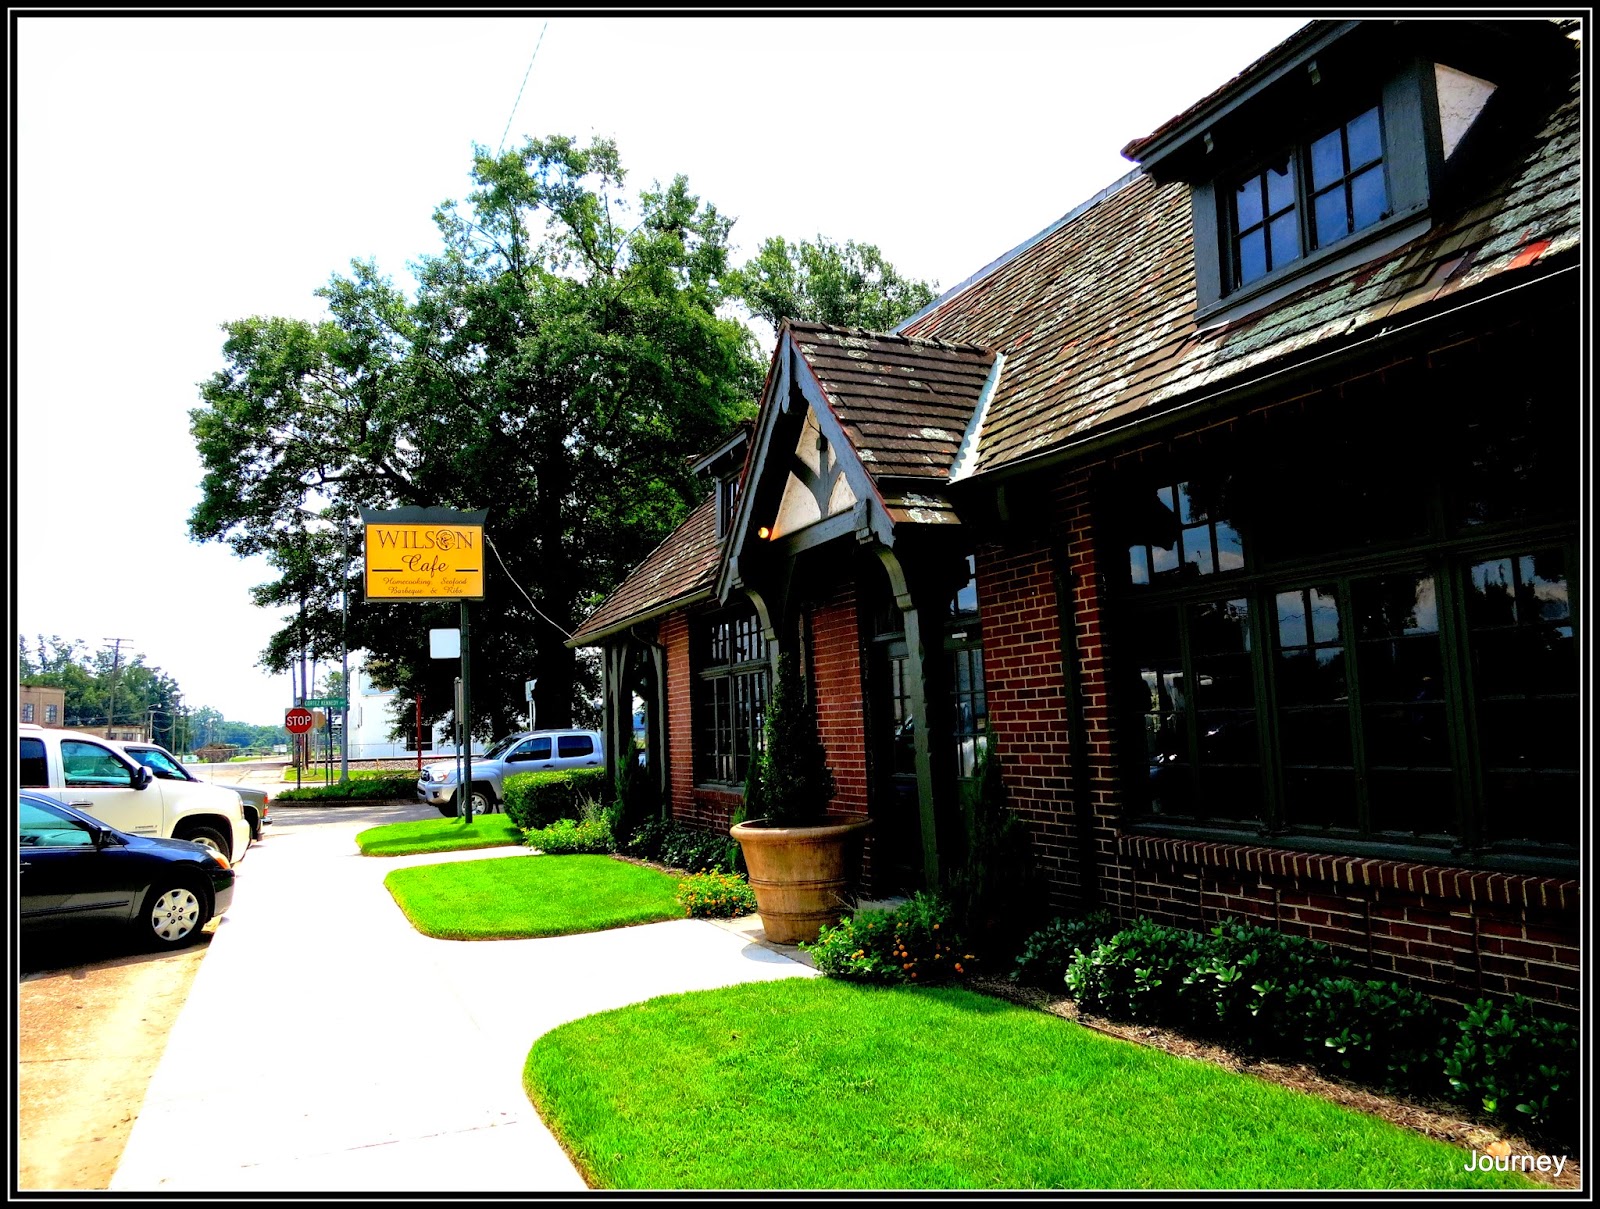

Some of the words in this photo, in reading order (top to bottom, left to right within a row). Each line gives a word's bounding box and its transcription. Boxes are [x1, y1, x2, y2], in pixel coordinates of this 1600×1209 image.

[376, 529, 474, 551] WILSON
[401, 553, 449, 578] Cafe
[440, 577, 468, 587] Seafood
[430, 587, 438, 595] &
[443, 586, 464, 595] Ribs
[286, 715, 311, 726] STOP
